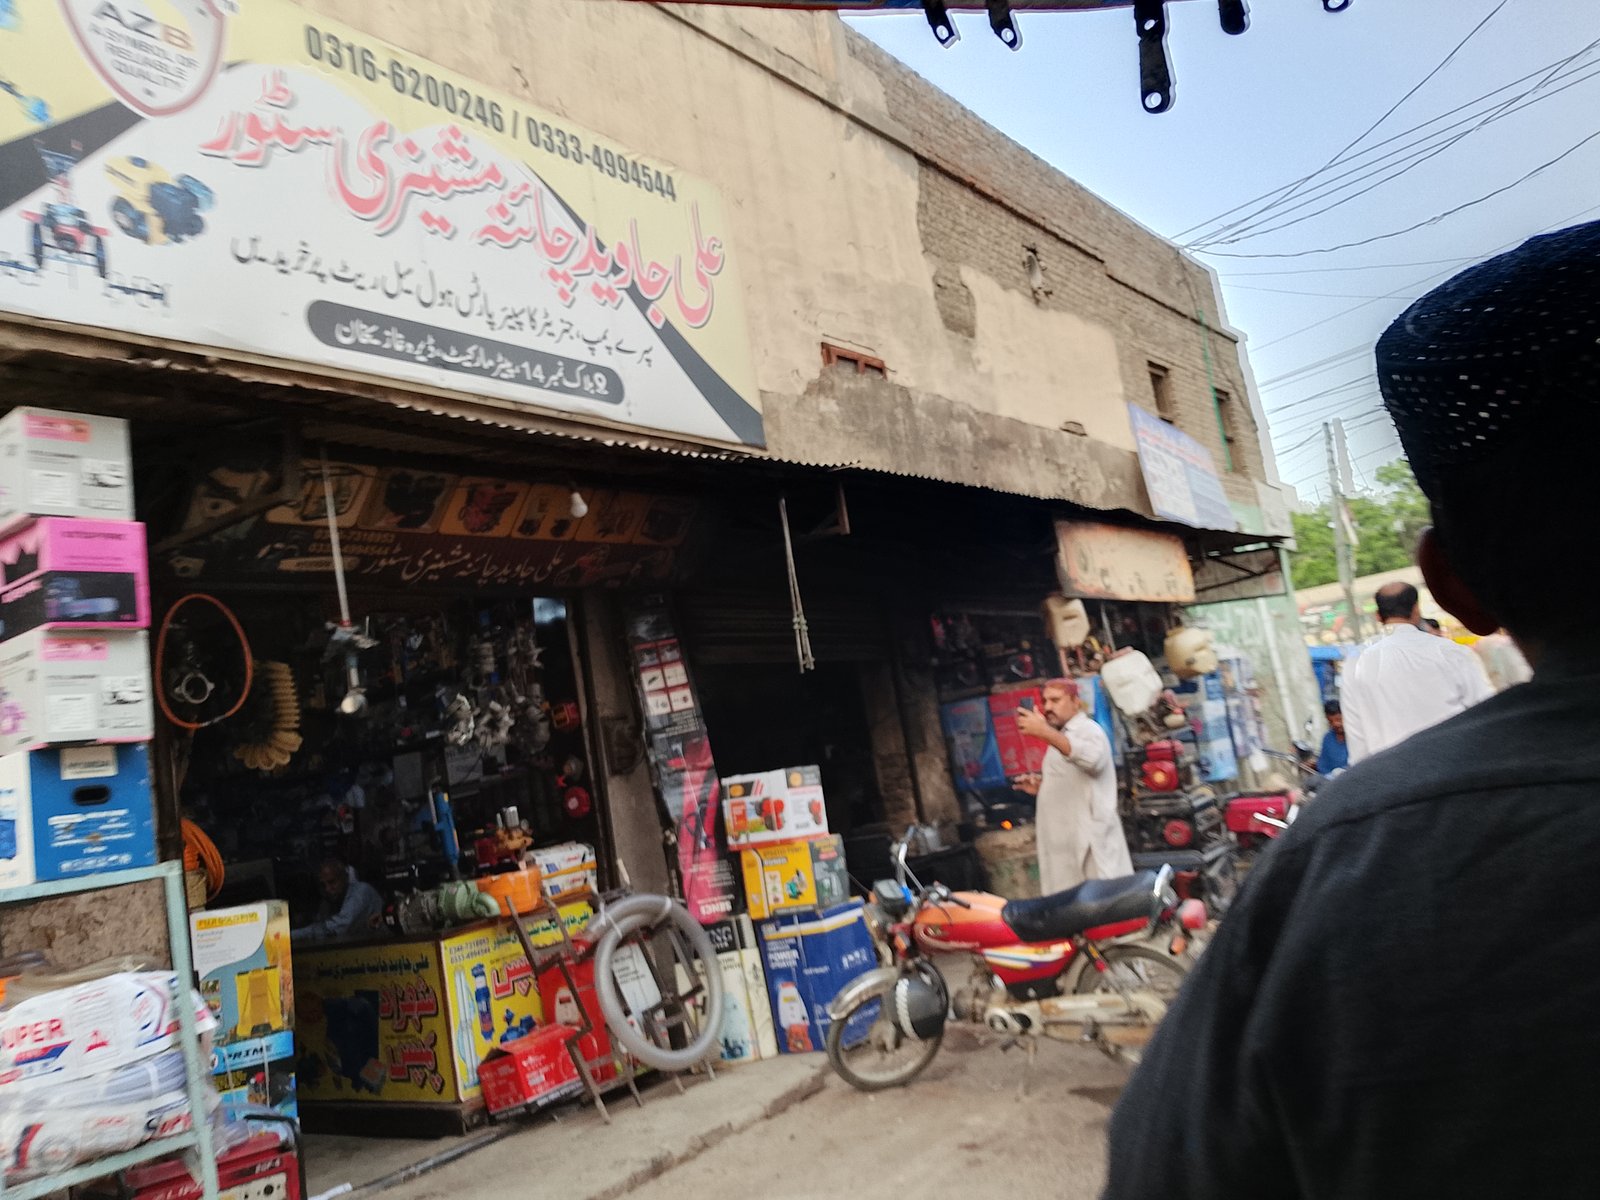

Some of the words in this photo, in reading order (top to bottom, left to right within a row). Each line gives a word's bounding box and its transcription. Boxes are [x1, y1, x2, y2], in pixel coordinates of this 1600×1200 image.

[305, 25, 505, 134] 0316-6200246
[526, 116, 678, 201] 0333-4994544
[1, 1016, 66, 1051] UPER
